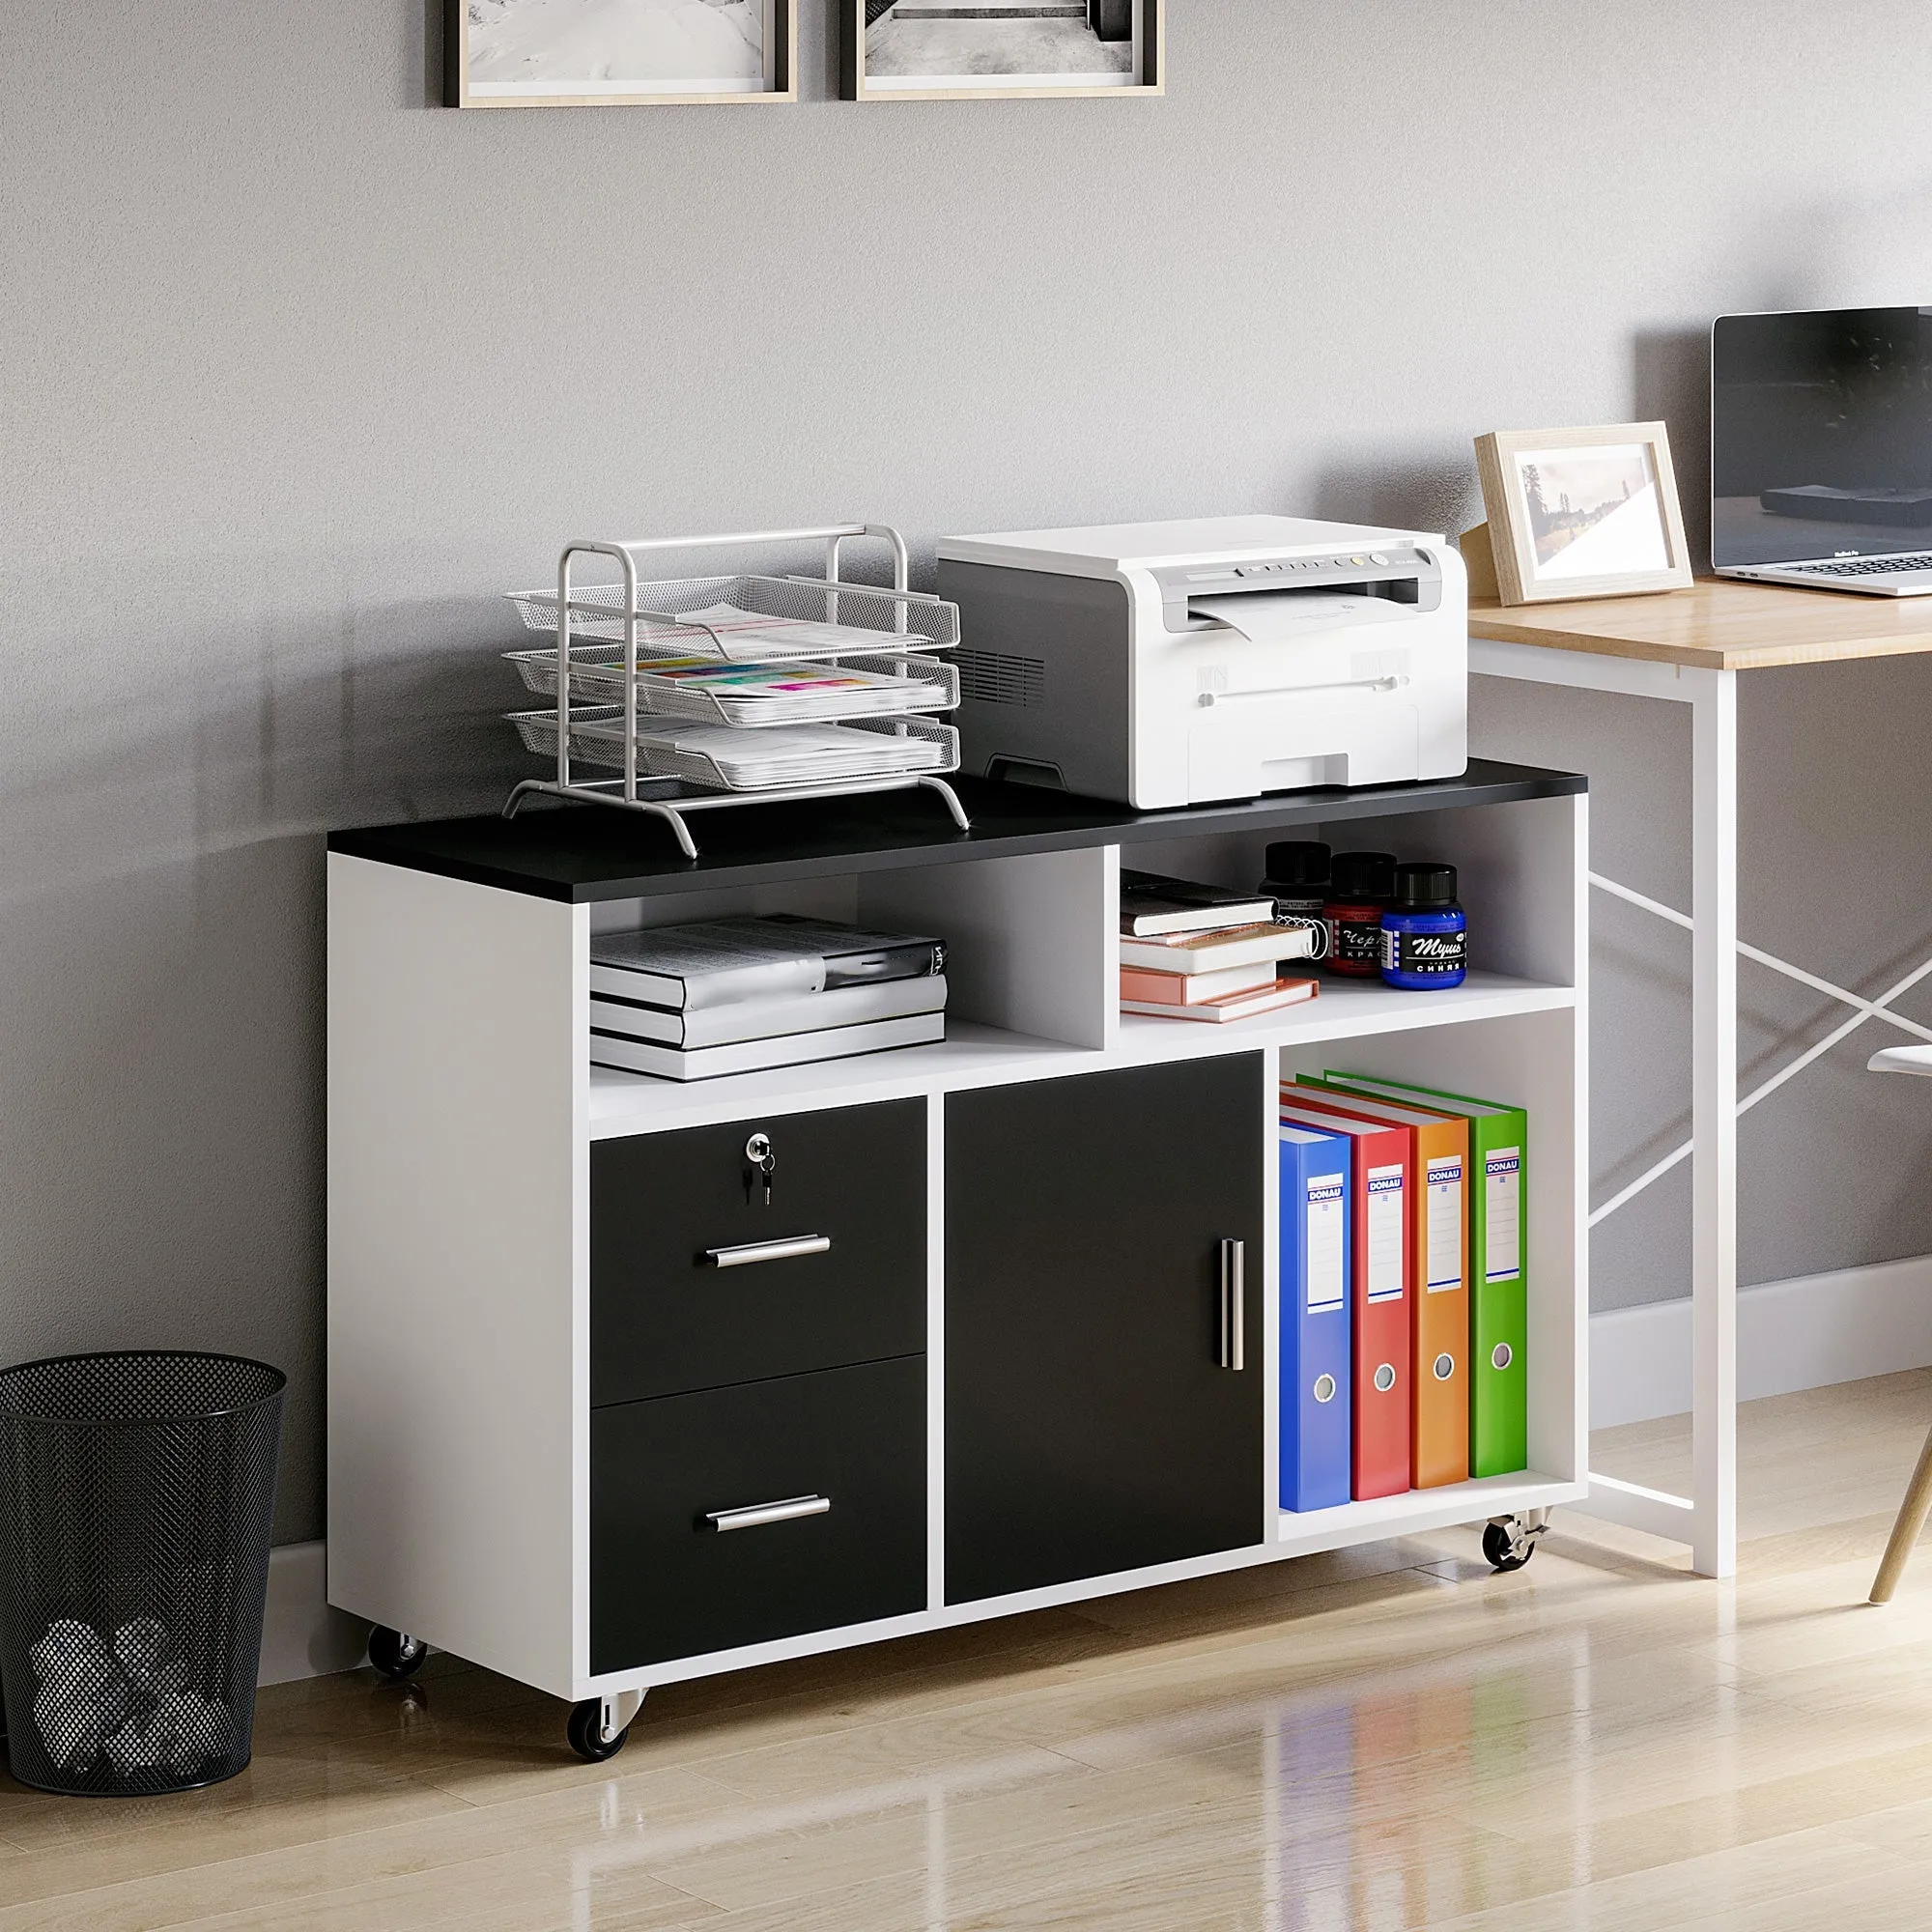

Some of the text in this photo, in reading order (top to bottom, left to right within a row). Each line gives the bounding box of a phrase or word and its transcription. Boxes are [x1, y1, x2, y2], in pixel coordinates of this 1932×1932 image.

[1343, 930, 1381, 948] Чер
[1488, 1160, 1518, 1173] DONAU
[1429, 1169, 1460, 1181] DONAU
[1369, 1179, 1401, 1191] DONAU
[1309, 1187, 1341, 1200] DONAU
